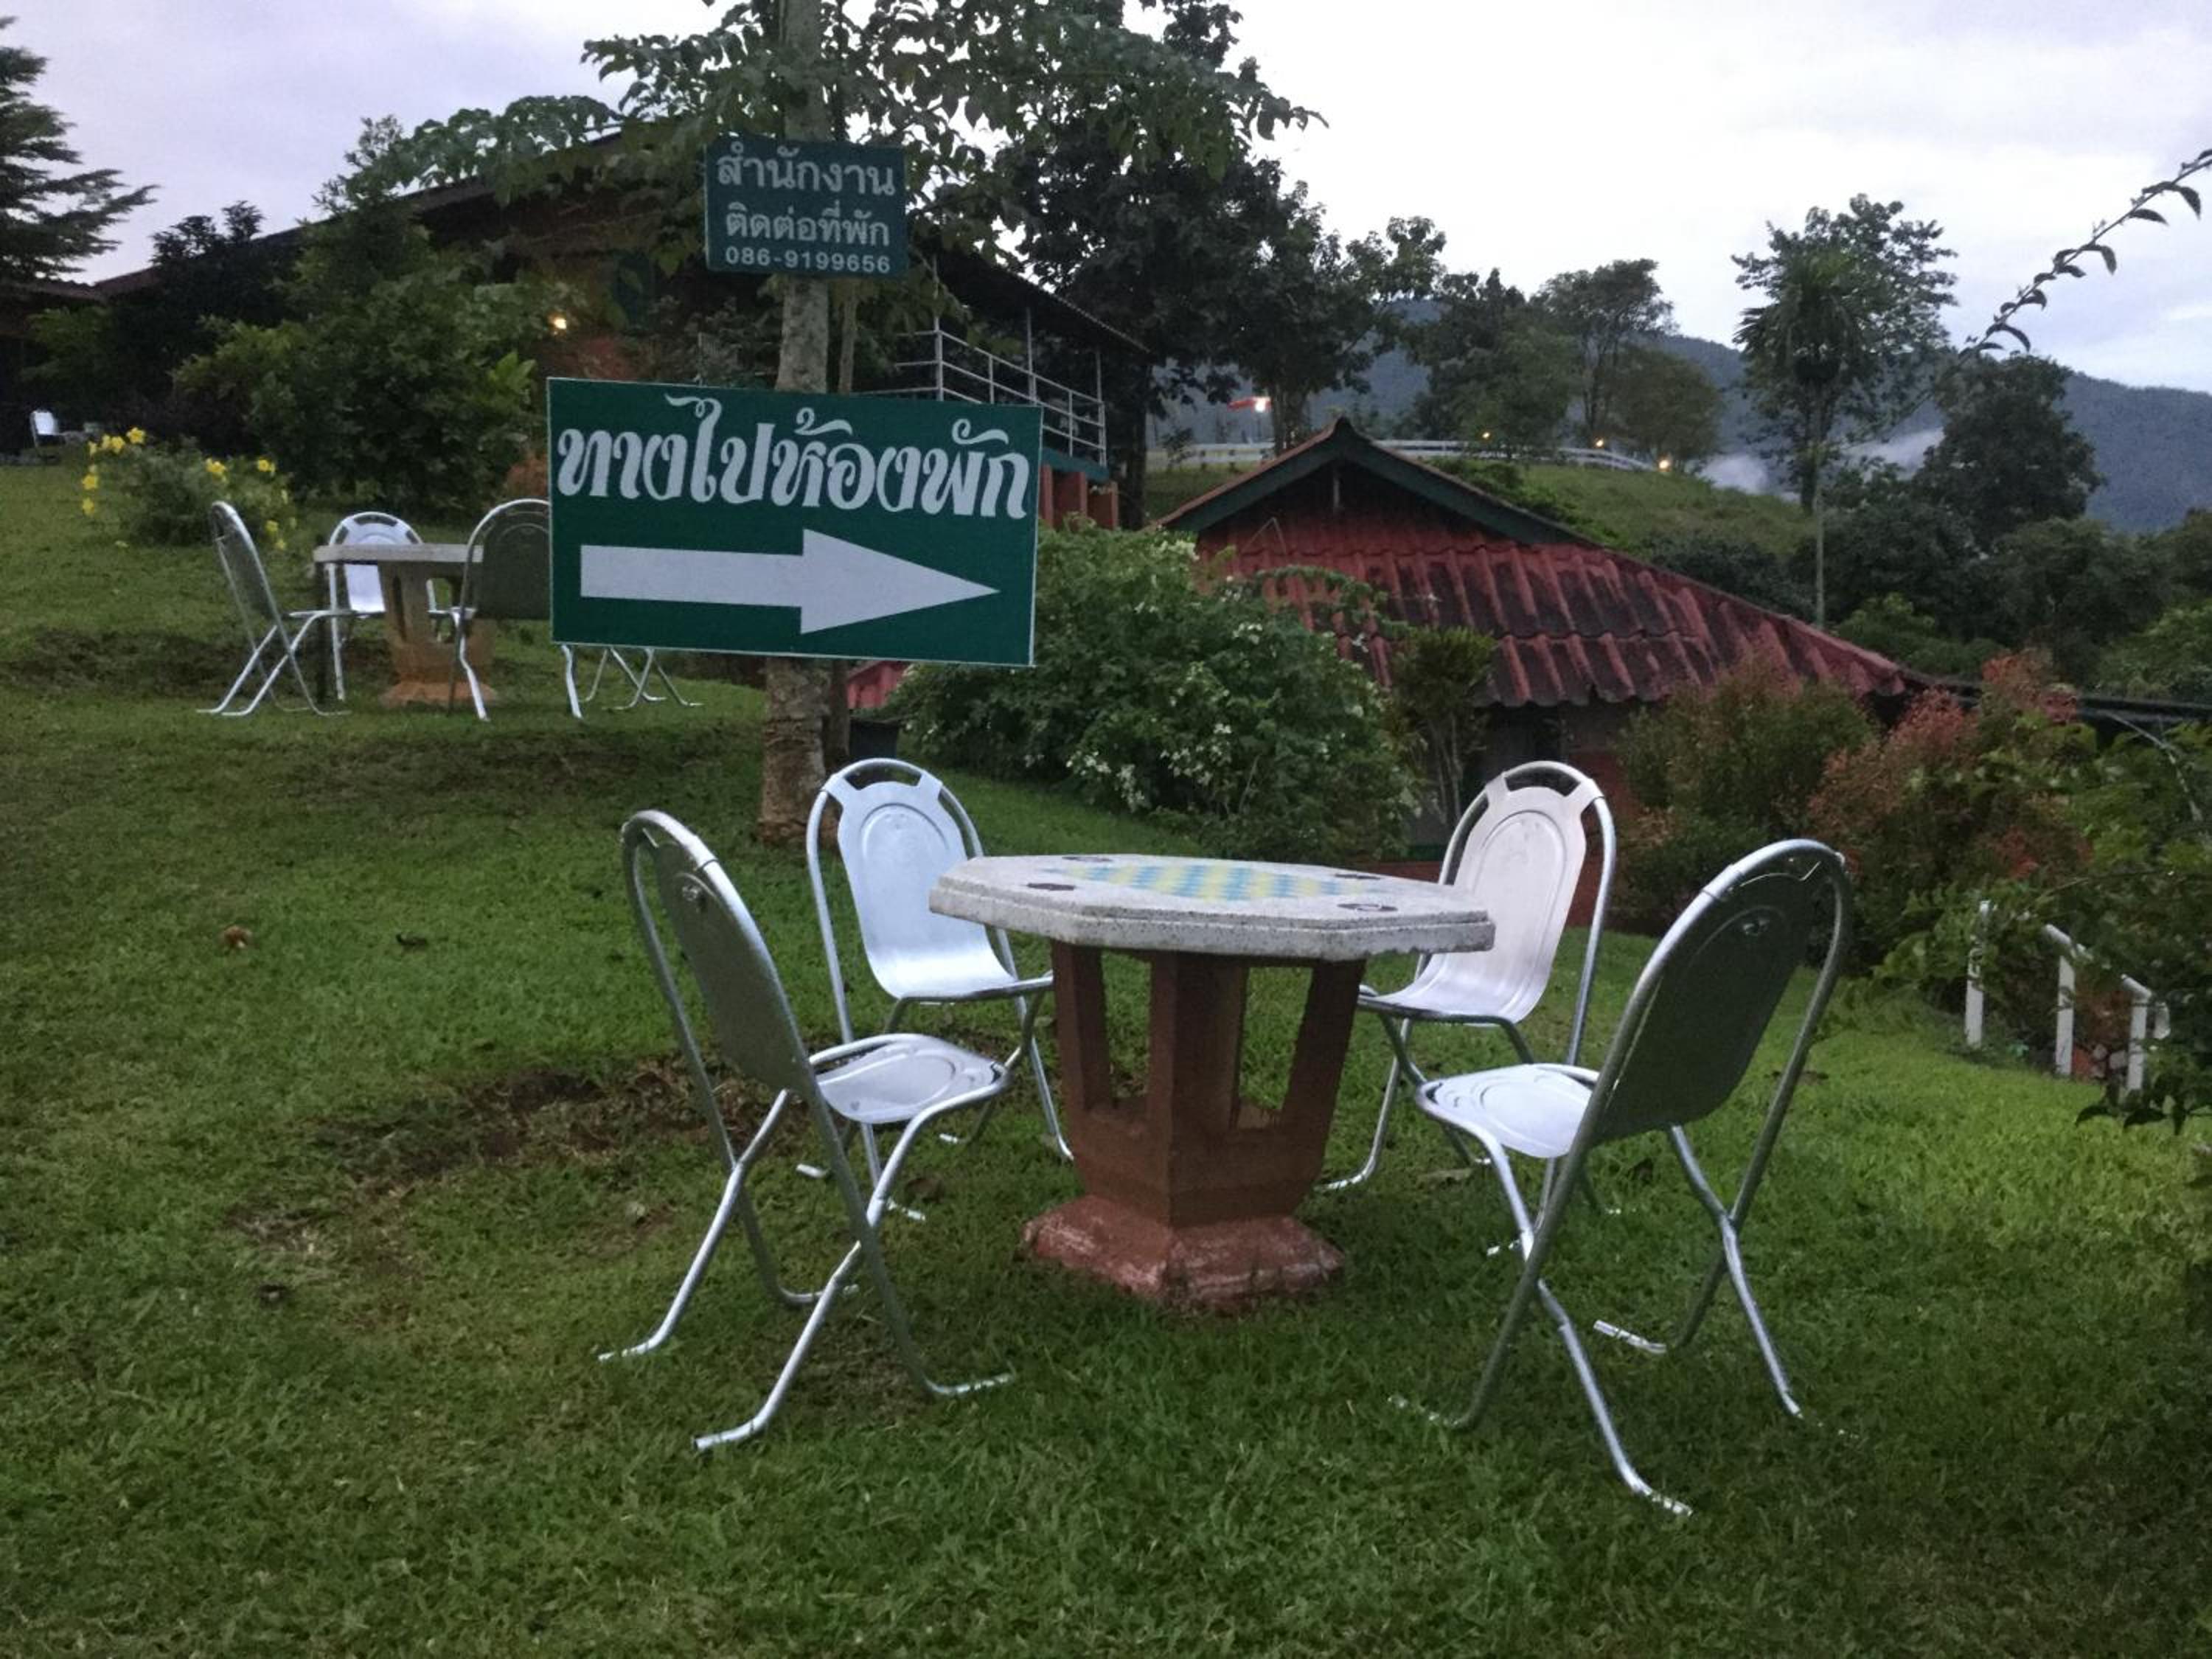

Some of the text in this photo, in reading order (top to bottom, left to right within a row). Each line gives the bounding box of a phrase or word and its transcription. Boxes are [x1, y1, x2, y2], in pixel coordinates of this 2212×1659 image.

[716, 140, 897, 197] สำนักงาน
[725, 200, 890, 246] ติดต่อที่พัก
[725, 246, 891, 274] 086-9199656
[556, 393, 1030, 520] ทางไปห้องพัก
